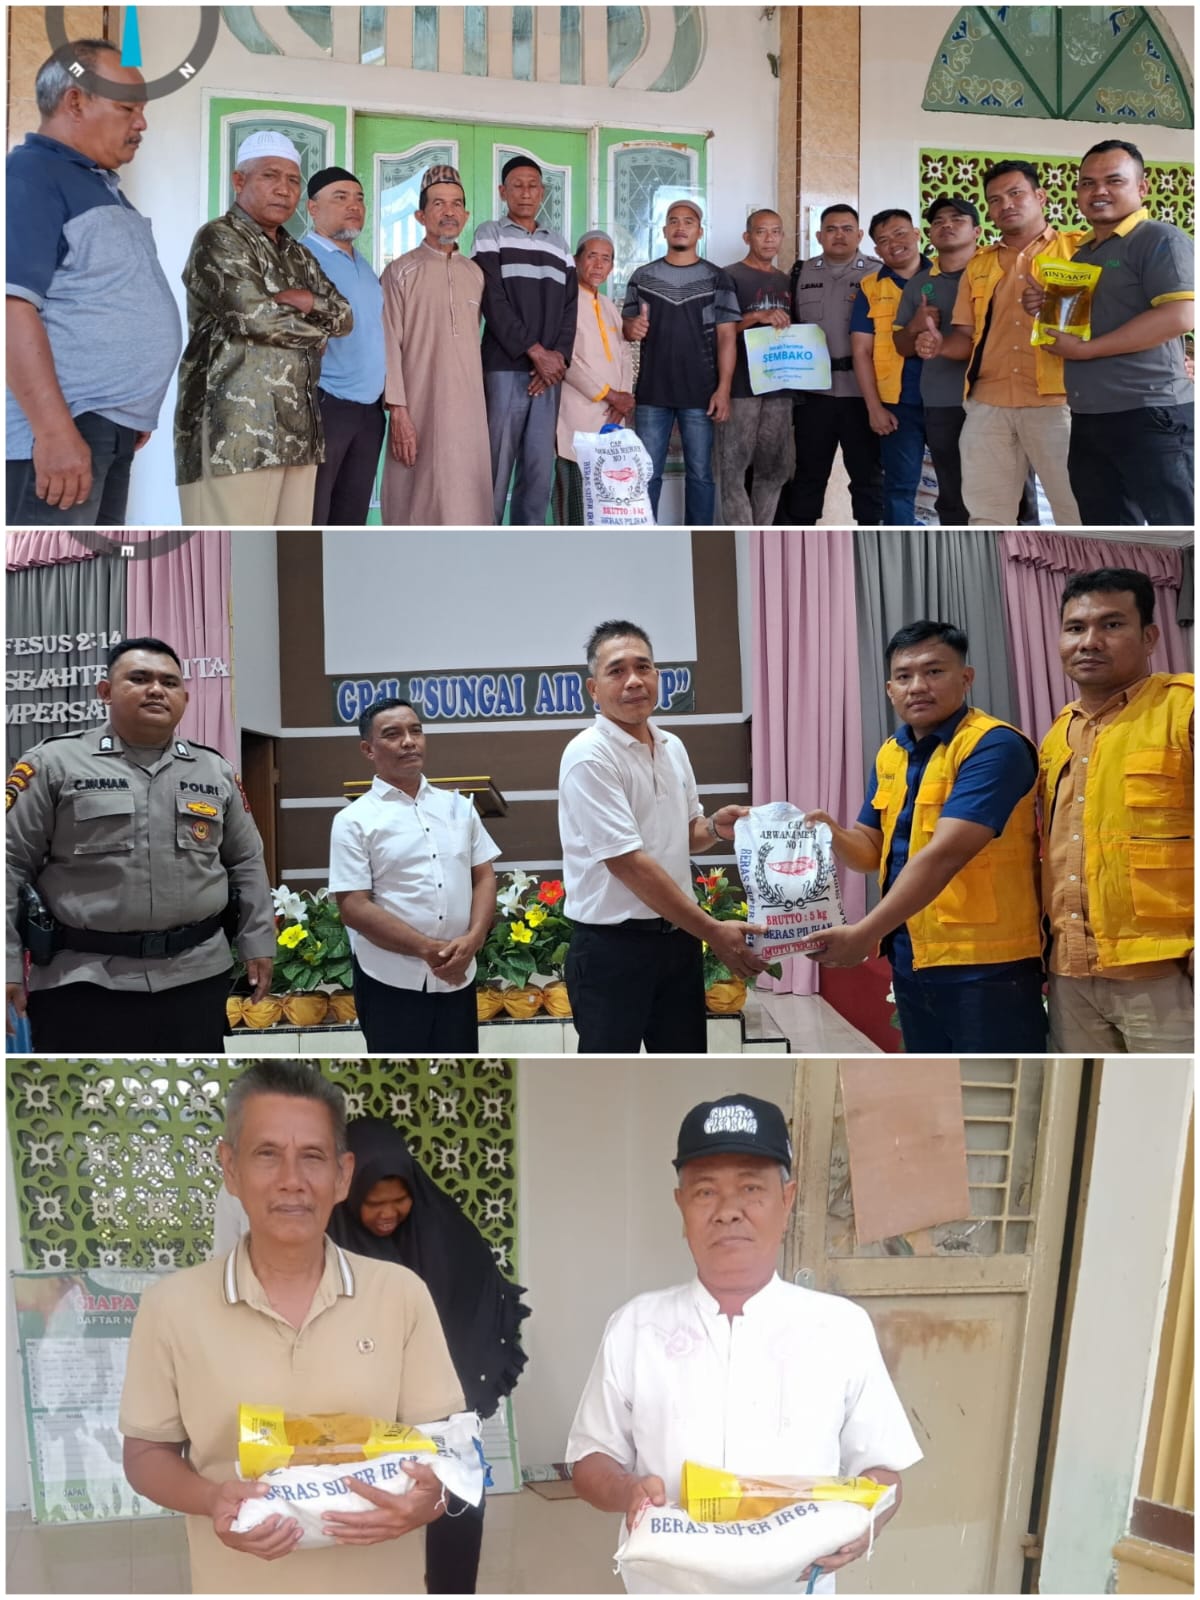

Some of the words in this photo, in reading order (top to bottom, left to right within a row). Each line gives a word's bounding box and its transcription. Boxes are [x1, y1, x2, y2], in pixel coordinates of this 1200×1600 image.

[763, 351, 813, 363] SEMBAKO
[6, 664, 108, 691] SEJAHTE
[182, 656, 231, 680] ITA
[534, 671, 585, 715] AIR
[180, 781, 219, 796] POLRI
[766, 913, 803, 926] BRUTTO
[809, 911, 815, 921] 5
[322, 1467, 377, 1496] SUER
[650, 1517, 709, 1534] BERAS
